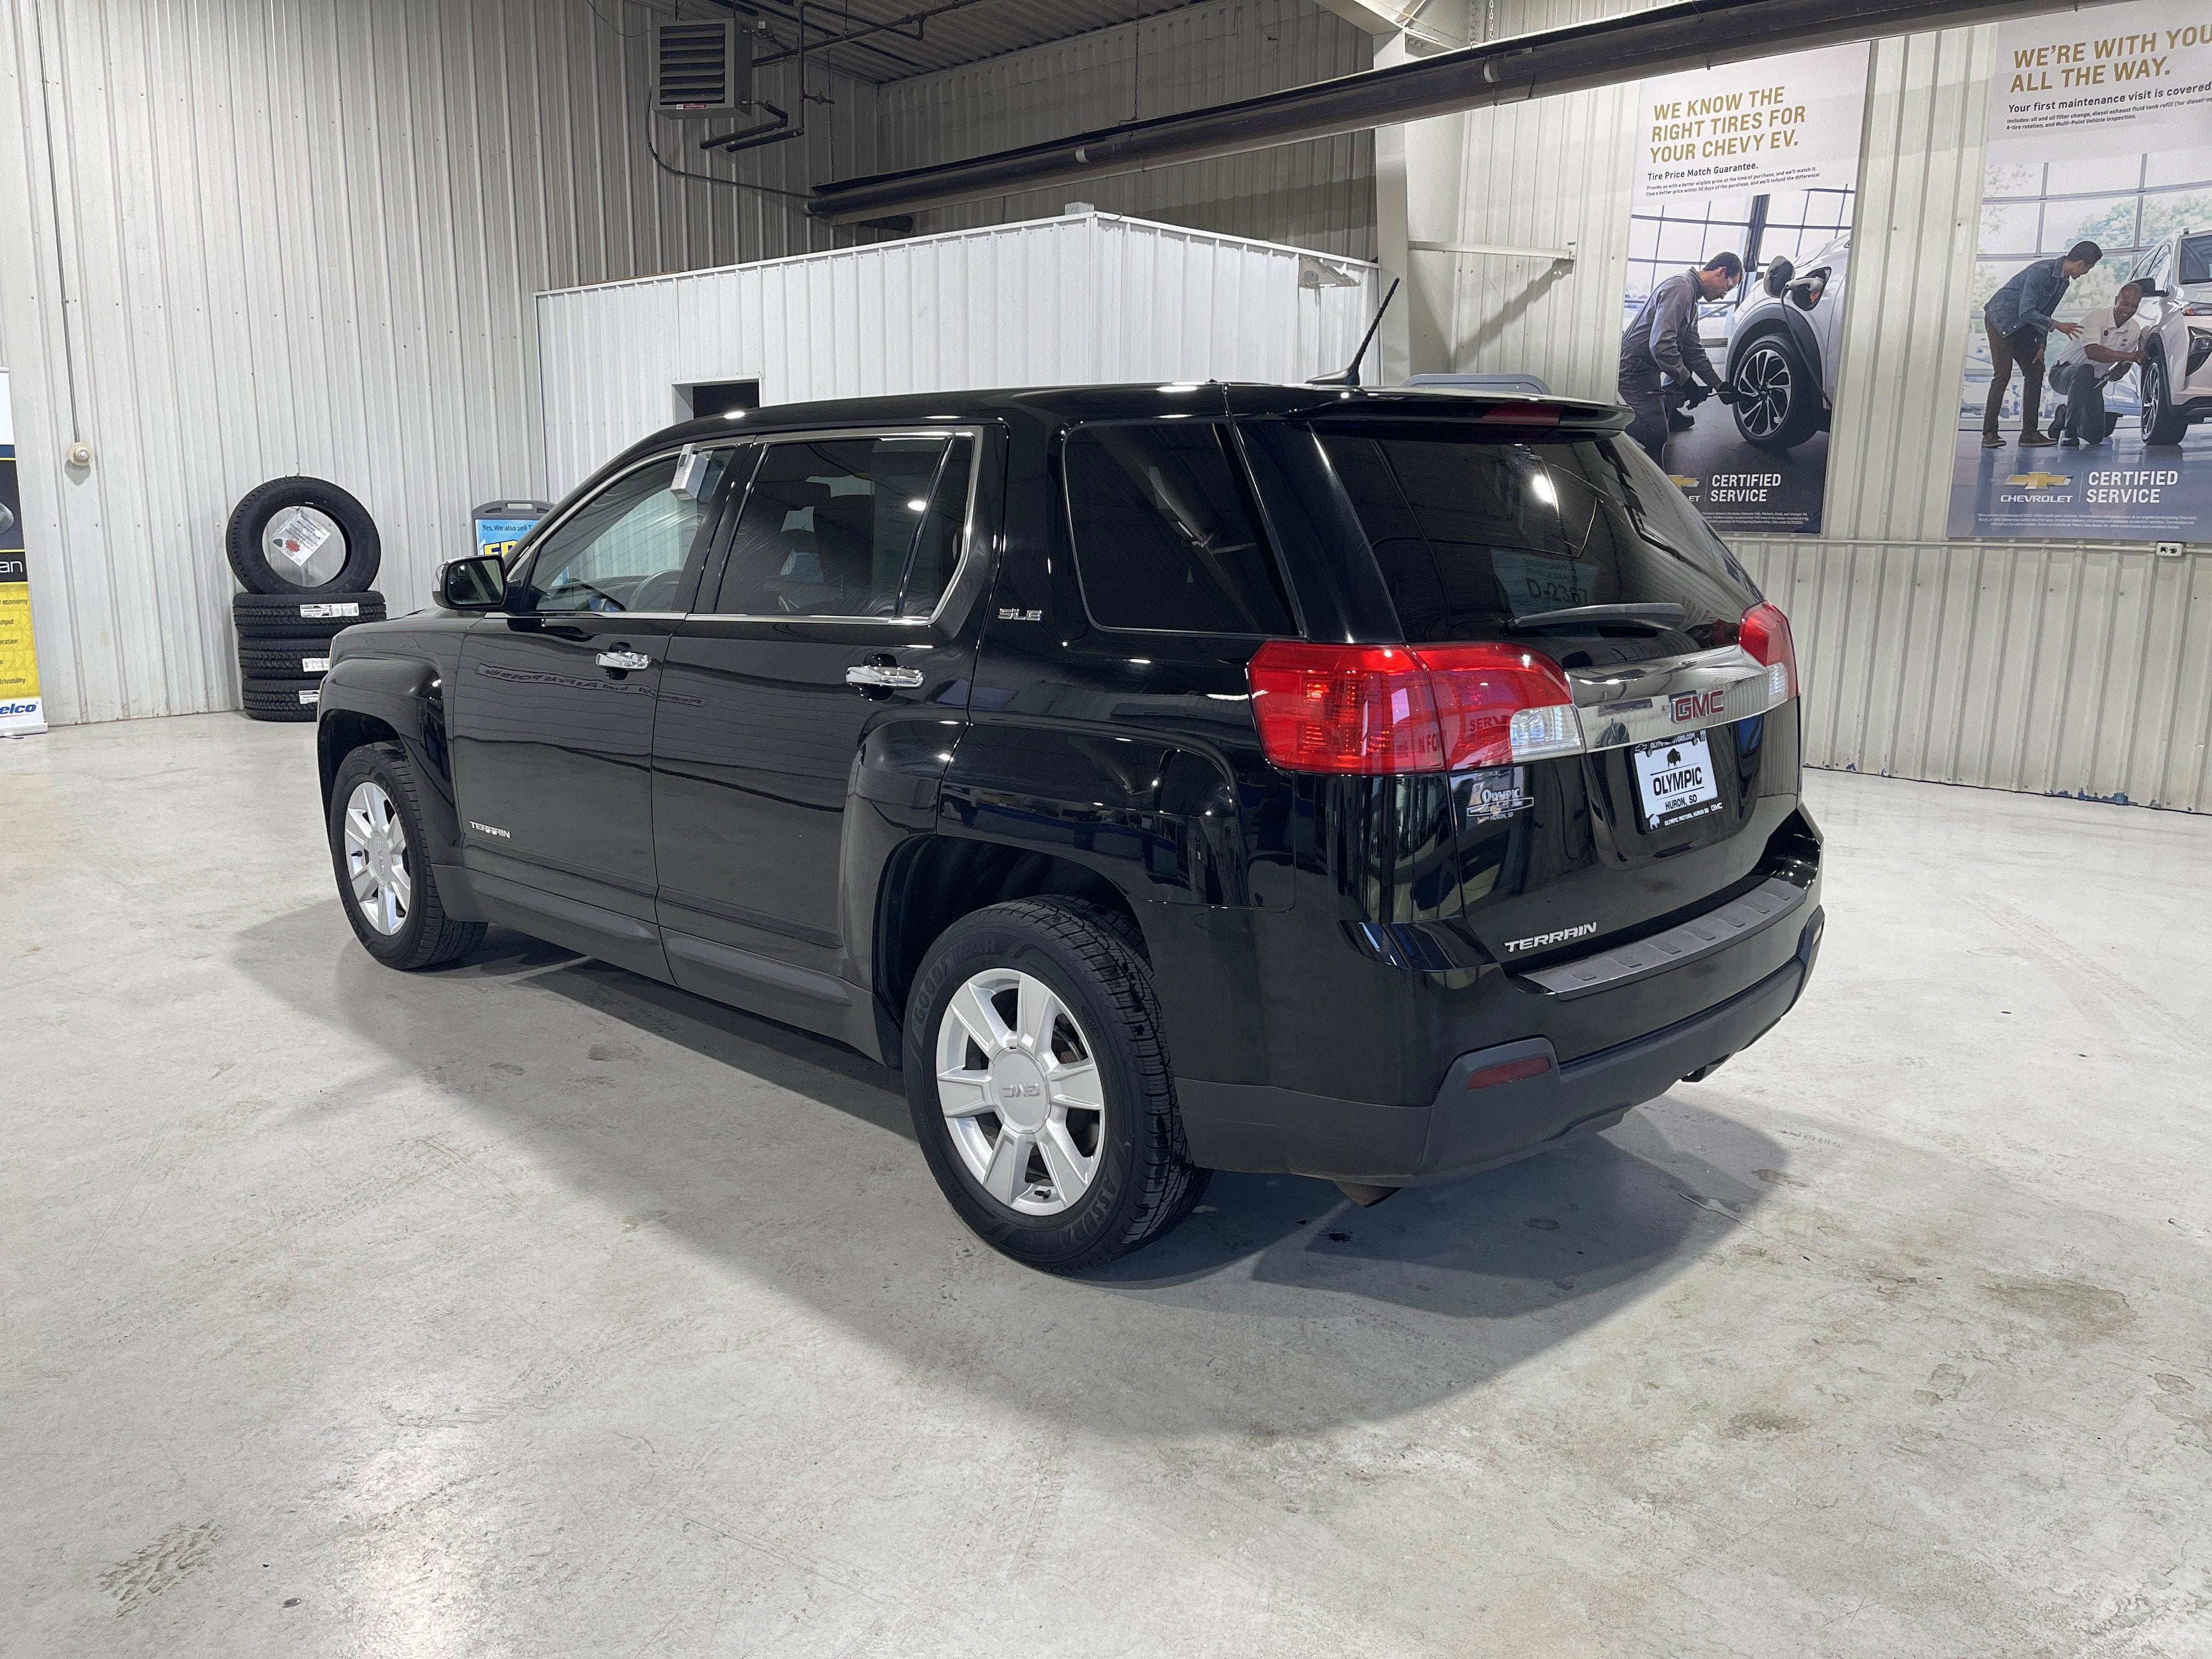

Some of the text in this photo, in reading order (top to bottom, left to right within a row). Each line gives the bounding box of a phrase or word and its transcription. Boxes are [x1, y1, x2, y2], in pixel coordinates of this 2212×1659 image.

[2094, 32, 2157, 59] WITH
[2165, 24, 2212, 49] YOU
[2010, 56, 2170, 93] ALL THE WAY.
[1654, 86, 1785, 121] WE KNOW THE
[2008, 104, 2031, 113] Your
[2034, 101, 2056, 111] first
[2058, 95, 2125, 109] maintenance
[2129, 91, 2152, 101] visit
[2154, 88, 2163, 98] is
[1652, 105, 1806, 143] RIGHT TIRES FOR
[1650, 129, 1798, 163] YOUR CHEVY EV.
[1648, 163, 1758, 181] Tire Price Match Guarantee.
[1712, 473, 1781, 487] CERTIFIED
[2088, 471, 2178, 486] CERTIFIED
[1711, 489, 1768, 502] SERVICE
[2086, 489, 2160, 504] SERVICE
[998, 607, 1042, 621] SLE
[1672, 690, 1724, 723] GMC
[1653, 766, 1702, 796] OLYMPIC
[1481, 788, 1520, 803] OLYMPIC
[1665, 794, 1697, 810] HURON, SD
[1711, 802, 1723, 811] GMC
[470, 821, 511, 839] TERRAIN
[1504, 922, 1598, 952] TERRAIN
[915, 937, 996, 1024] GOODYEAR
[1001, 1082, 1041, 1097] GMC
